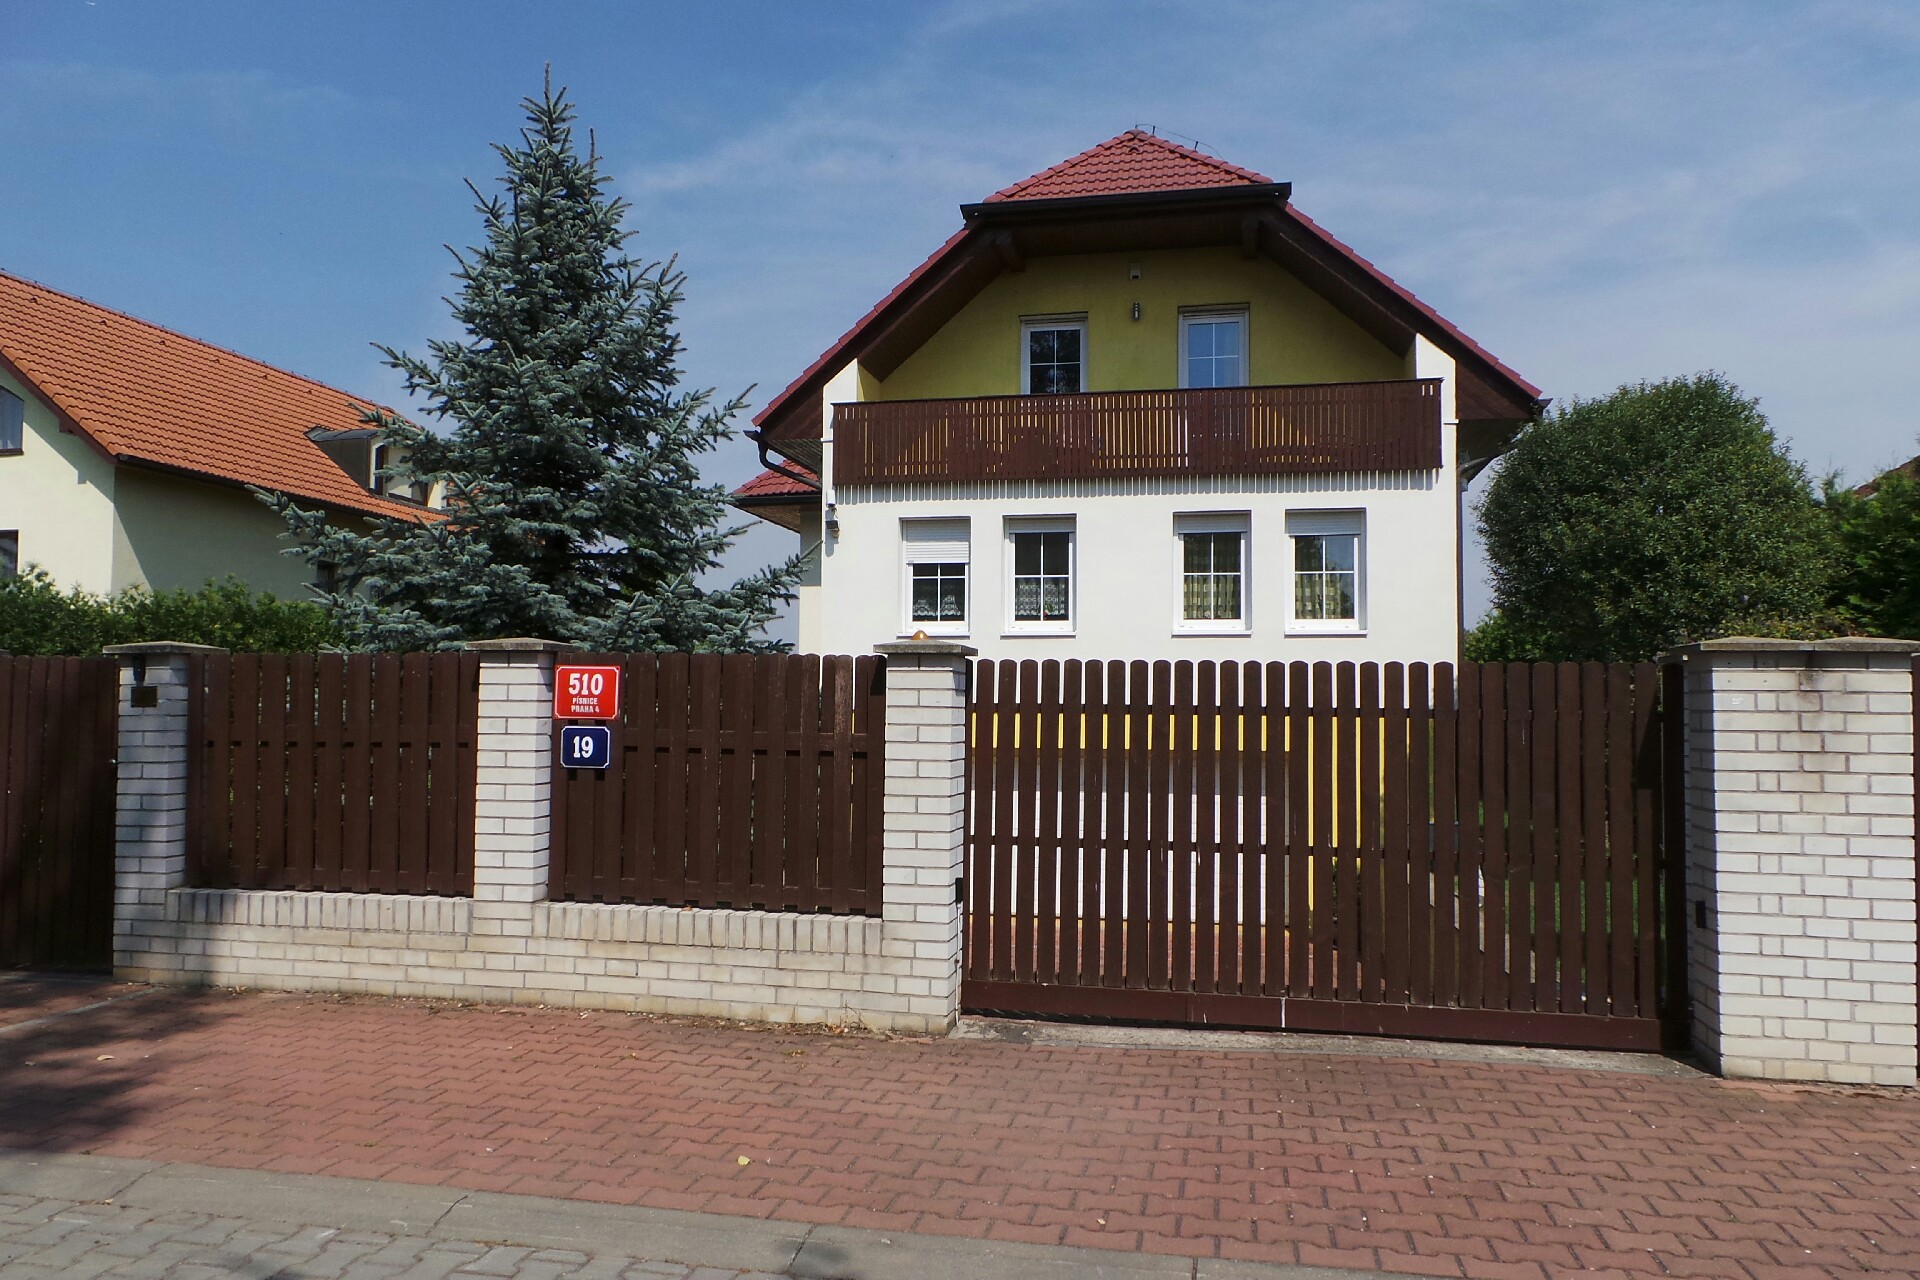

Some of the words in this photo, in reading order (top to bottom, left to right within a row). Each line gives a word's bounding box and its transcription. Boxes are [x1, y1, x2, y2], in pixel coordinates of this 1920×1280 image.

[568, 673, 604, 695] 510
[572, 696, 598, 704] PÍSNICE
[594, 705, 600, 713] 4
[573, 735, 593, 758] 19
